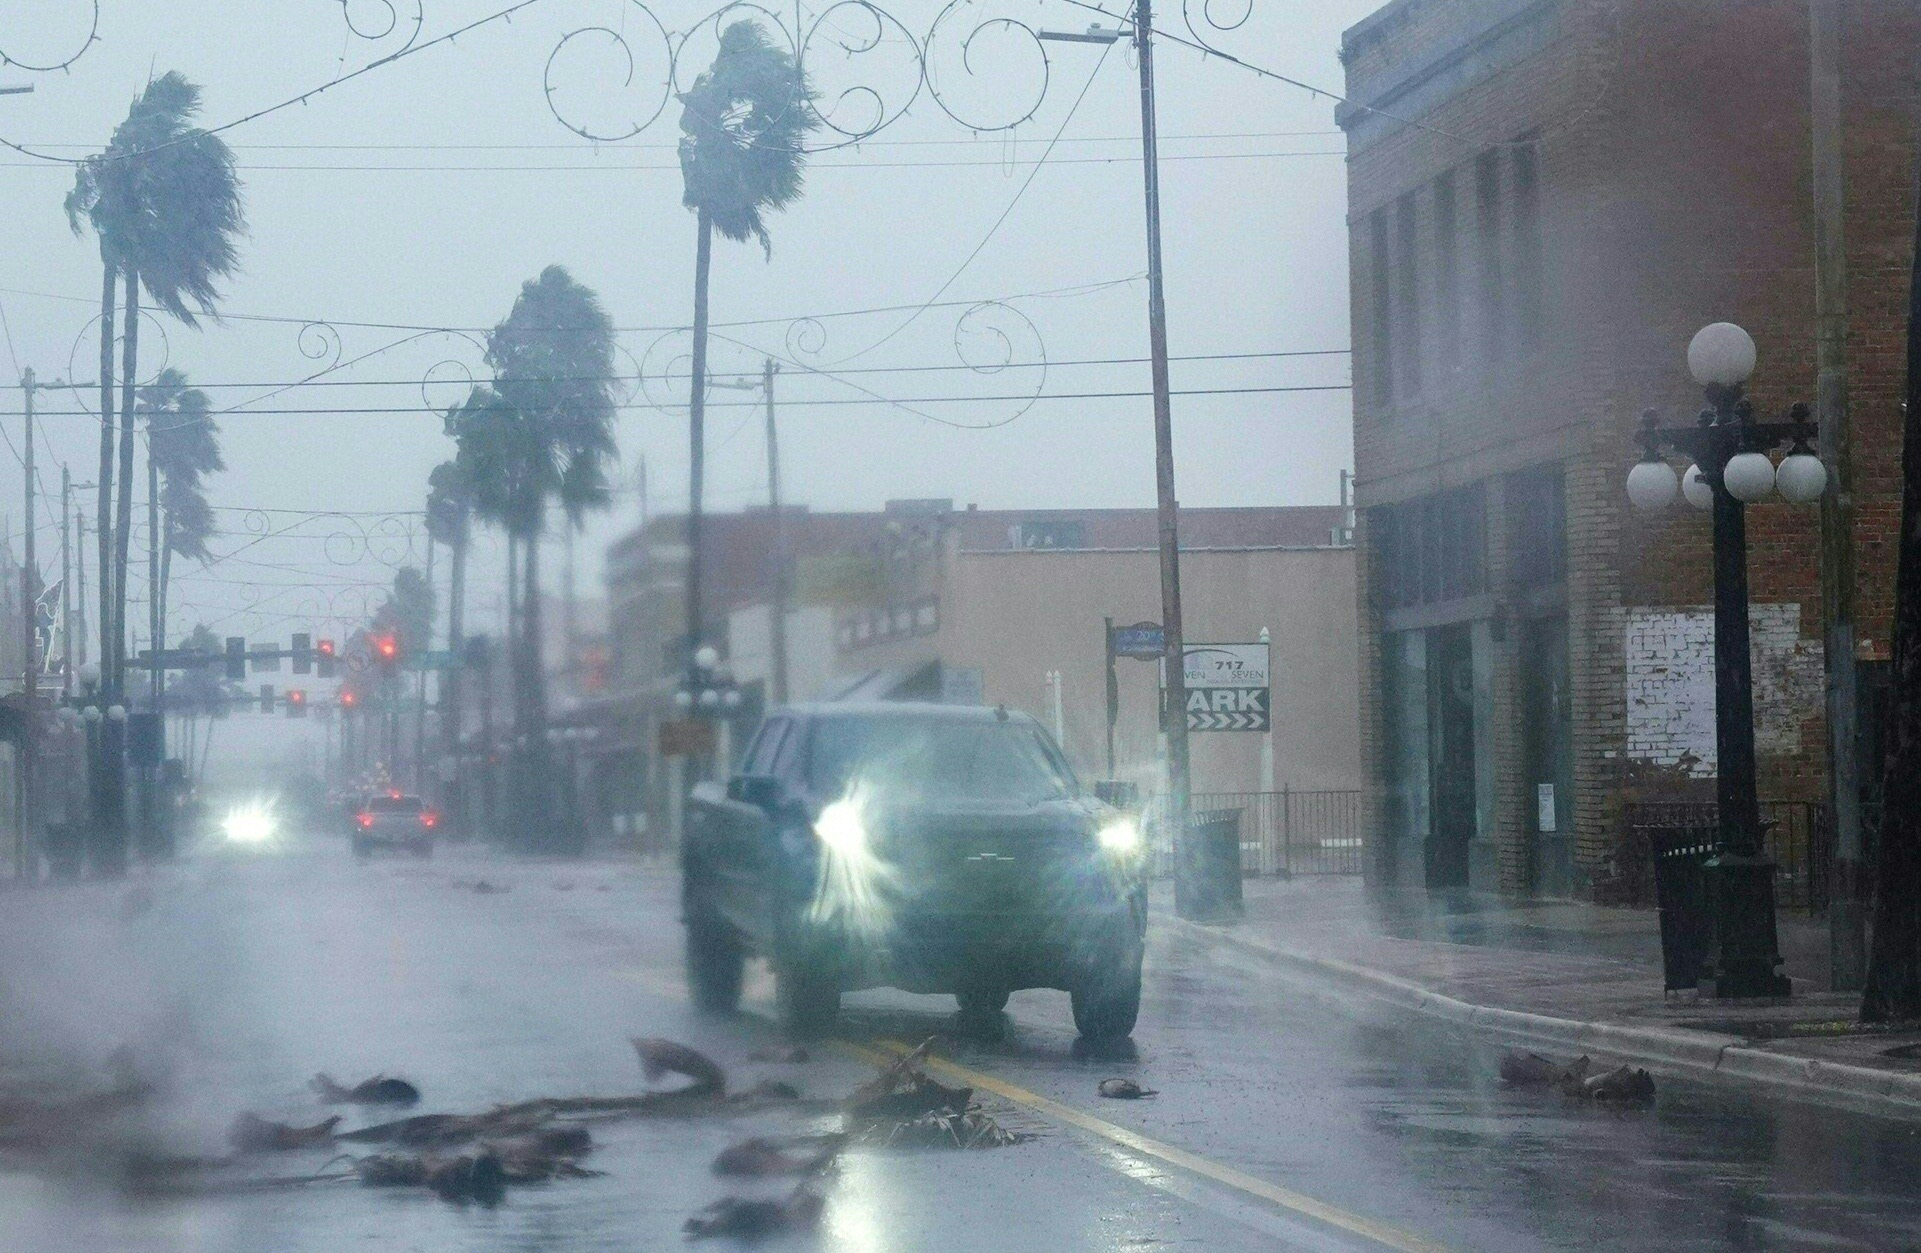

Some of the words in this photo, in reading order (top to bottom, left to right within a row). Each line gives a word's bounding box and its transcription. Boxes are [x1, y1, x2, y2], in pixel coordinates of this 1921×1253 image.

[1215, 661, 1244, 670] 717
[1184, 671, 1206, 679] VEN
[1231, 670, 1264, 679] SEVEN
[1164, 690, 1264, 711] ARK
